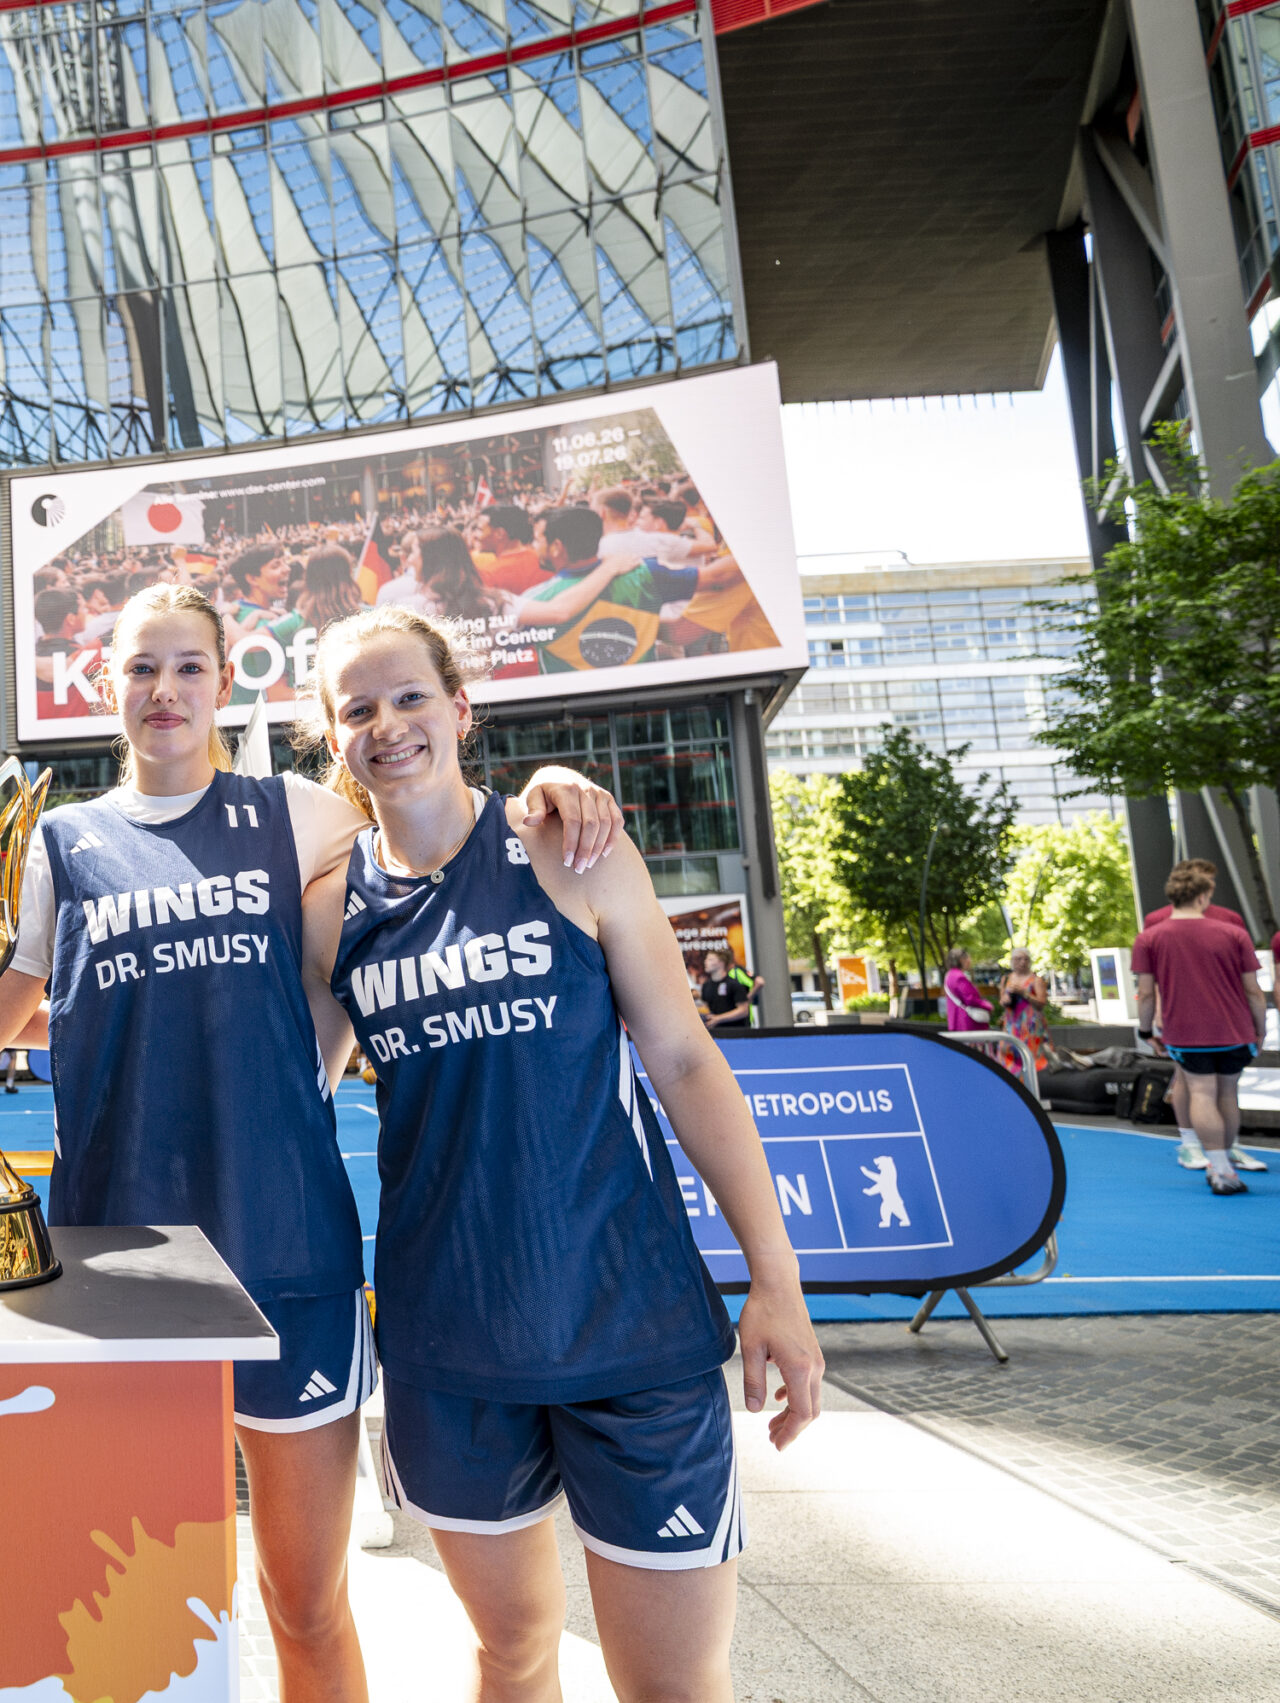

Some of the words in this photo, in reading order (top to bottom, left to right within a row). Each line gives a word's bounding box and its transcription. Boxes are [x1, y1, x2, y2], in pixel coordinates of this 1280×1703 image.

[490, 649, 535, 665] Platz
[495, 627, 556, 646] Center
[224, 803, 259, 828] 11
[505, 837, 531, 865] 8
[82, 869, 270, 945] WINGS
[95, 952, 146, 990] DR.
[153, 933, 269, 974] SMUSY
[351, 919, 553, 1018] WINGS
[369, 1026, 421, 1063] DR.
[422, 995, 558, 1049] SMUSY
